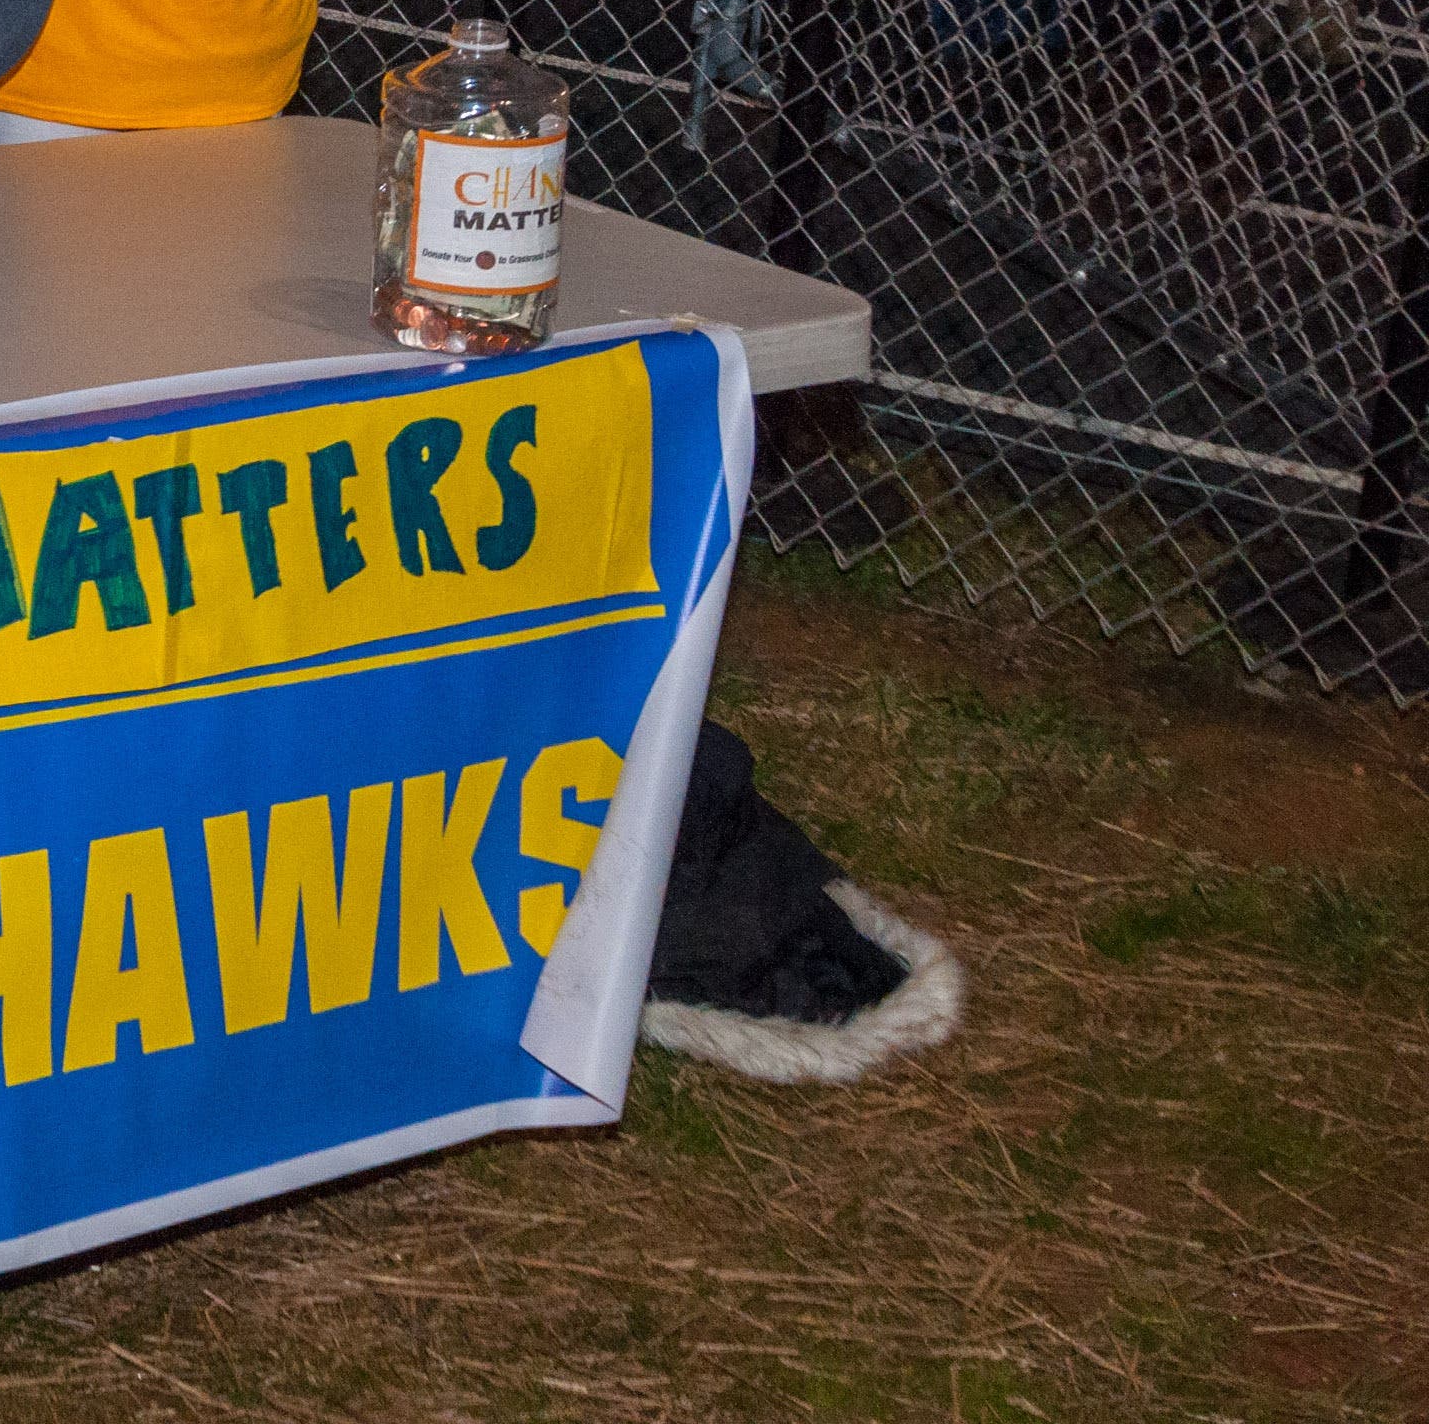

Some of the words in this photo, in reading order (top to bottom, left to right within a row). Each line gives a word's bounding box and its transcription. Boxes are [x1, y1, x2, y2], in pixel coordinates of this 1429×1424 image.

[454, 164, 563, 209] CHAN
[453, 202, 563, 232] MATTE
[422, 248, 452, 261] Donate
[454, 254, 474, 264] Your
